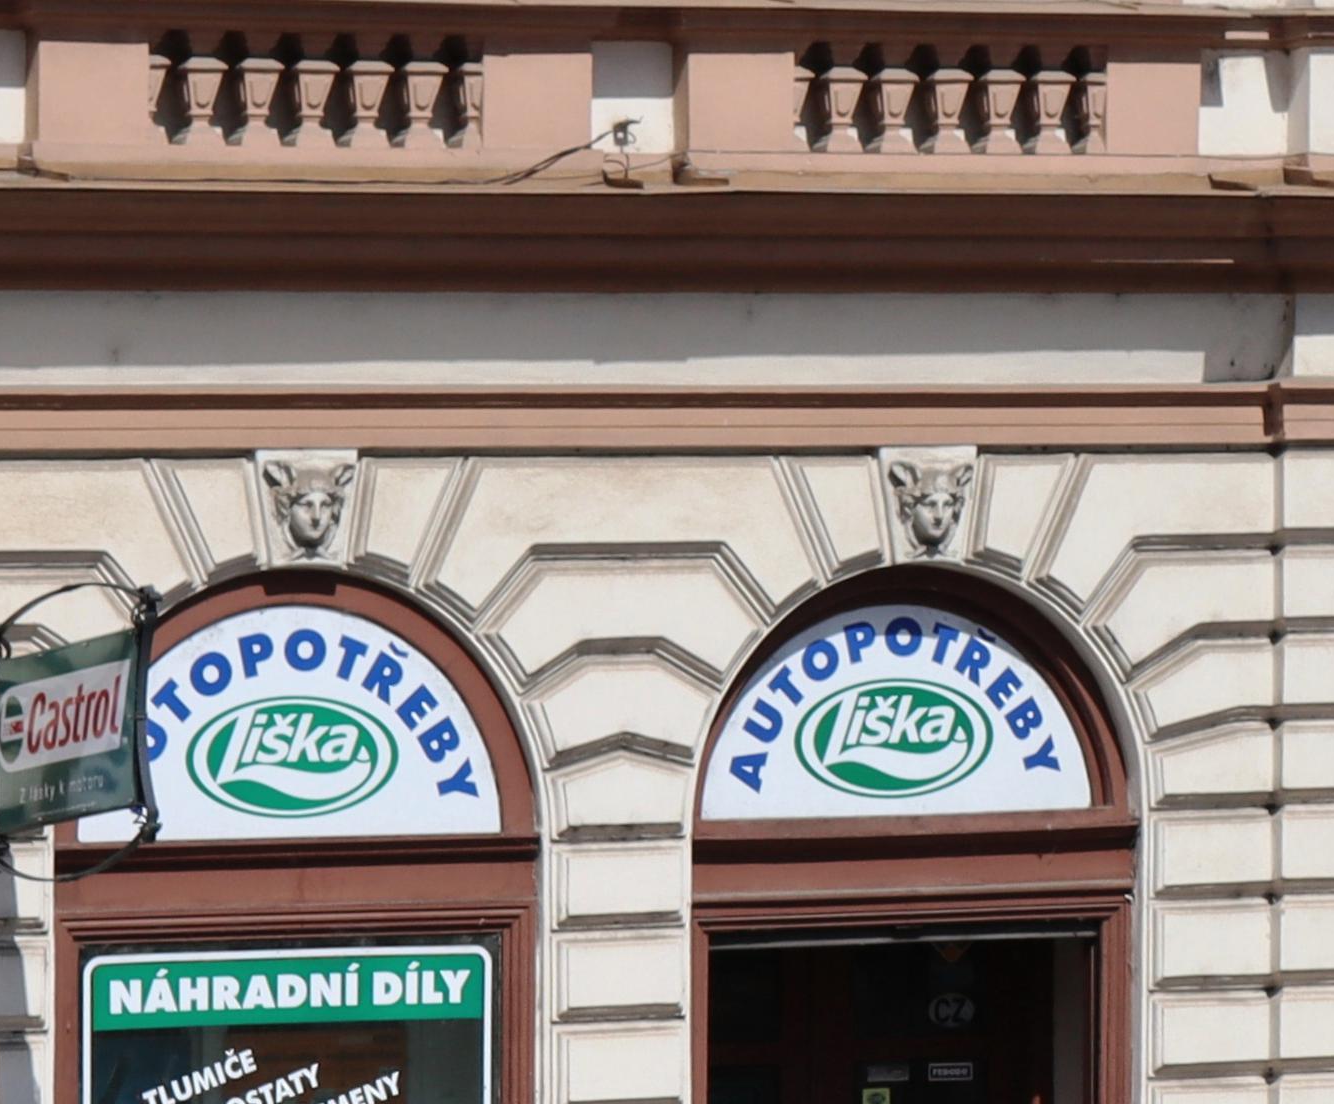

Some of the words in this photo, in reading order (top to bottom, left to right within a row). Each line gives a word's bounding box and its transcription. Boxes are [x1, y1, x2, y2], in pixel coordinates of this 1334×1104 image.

[27, 673, 122, 755] Castrol
[145, 628, 479, 799] UTOPOTŘEBY
[729, 616, 1061, 793] AUTOPOTŘEBY
[823, 690, 969, 781] Liška
[217, 706, 372, 801] Liška
[109, 963, 360, 1016] NÁHRADNÍ
[372, 960, 471, 1006] DÍLY
[934, 998, 966, 1023] CZ
